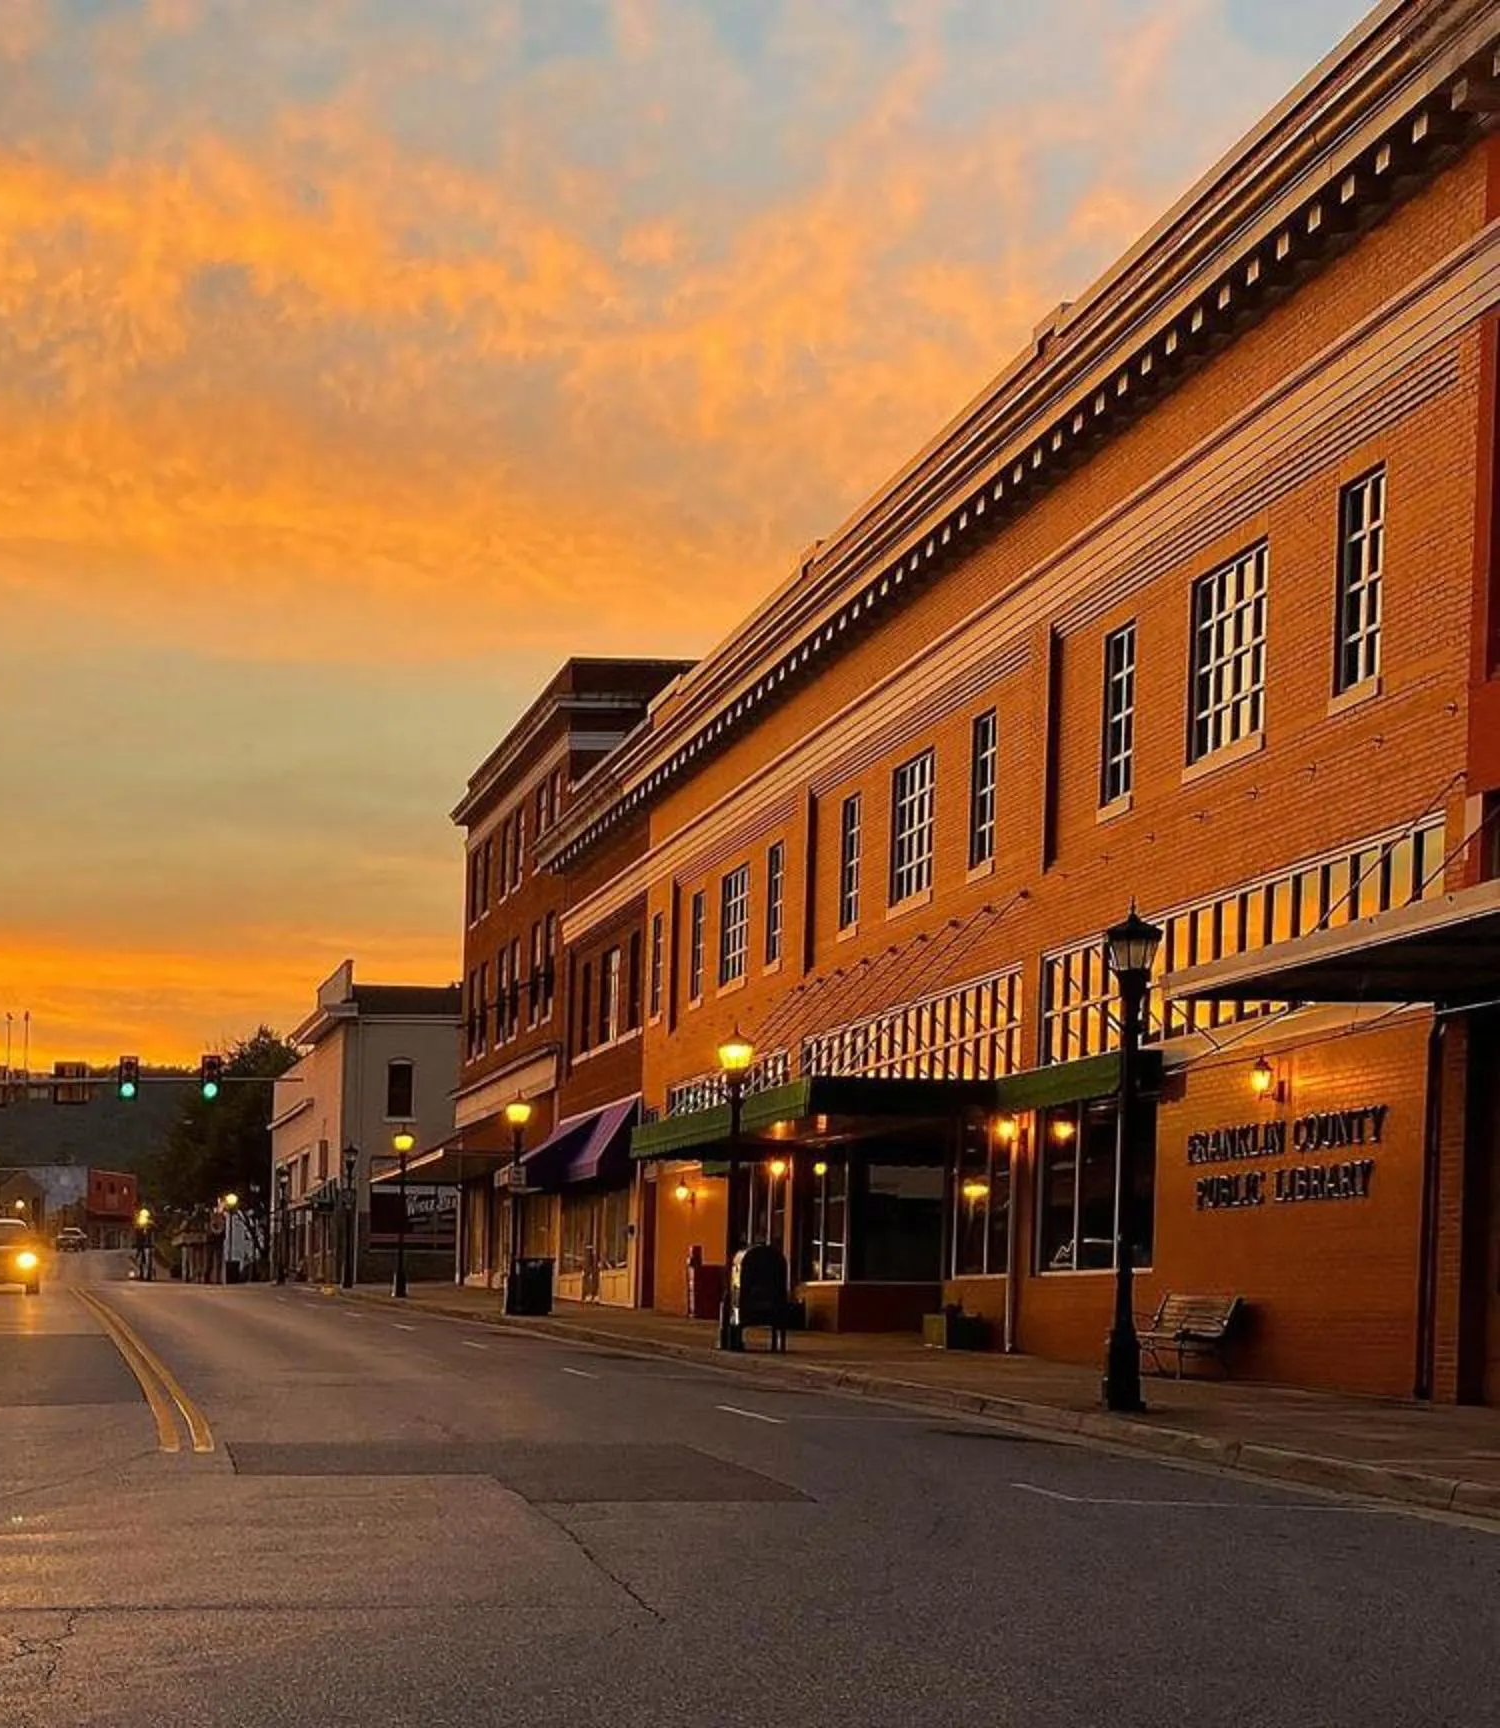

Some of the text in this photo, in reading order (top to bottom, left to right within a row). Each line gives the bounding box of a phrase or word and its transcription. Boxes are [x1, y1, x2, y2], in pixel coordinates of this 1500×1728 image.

[1188, 1104, 1389, 1165] FRANKLIN COUNTY
[1197, 1159, 1375, 1211] PUBLIC LIBRARY
